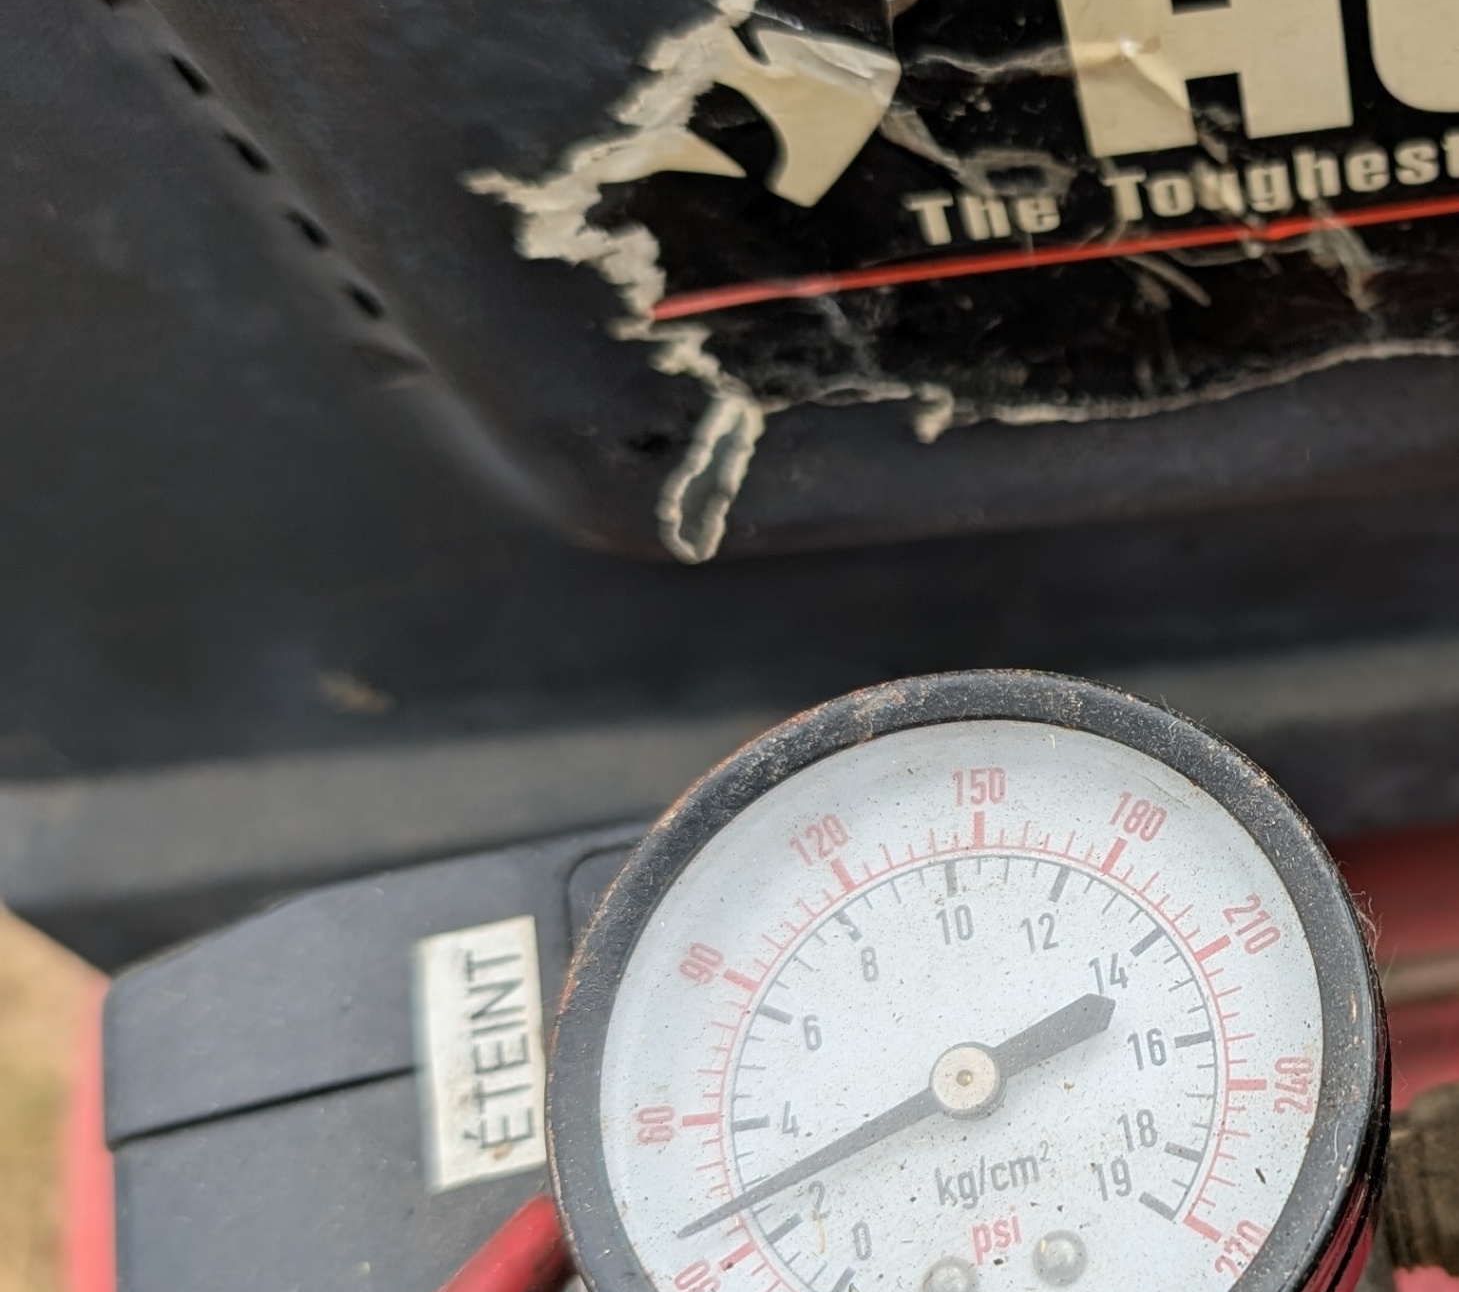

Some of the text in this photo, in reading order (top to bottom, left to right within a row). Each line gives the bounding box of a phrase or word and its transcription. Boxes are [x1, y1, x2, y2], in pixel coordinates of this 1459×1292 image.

[908, 194, 1061, 246] The
[952, 767, 1006, 806] 150
[1108, 791, 1167, 843] 180
[790, 813, 847, 867] 120
[935, 904, 974, 945] 10
[1020, 912, 1058, 952] 12
[1222, 892, 1281, 955] 210
[679, 942, 725, 985] 90
[861, 947, 879, 982] 8
[1087, 951, 1130, 991] 14
[464, 948, 535, 1149] ÉTEINT
[803, 1015, 823, 1052] 6
[1127, 1029, 1168, 1069] 16
[1273, 1055, 1315, 1114] 240
[638, 1106, 676, 1144] 60
[780, 1101, 799, 1138] 4
[1117, 1109, 1159, 1152] 18
[808, 1180, 831, 1222] 2
[1091, 1158, 1133, 1202] 19
[852, 1221, 872, 1260] 0
[972, 1205, 1022, 1265] psi
